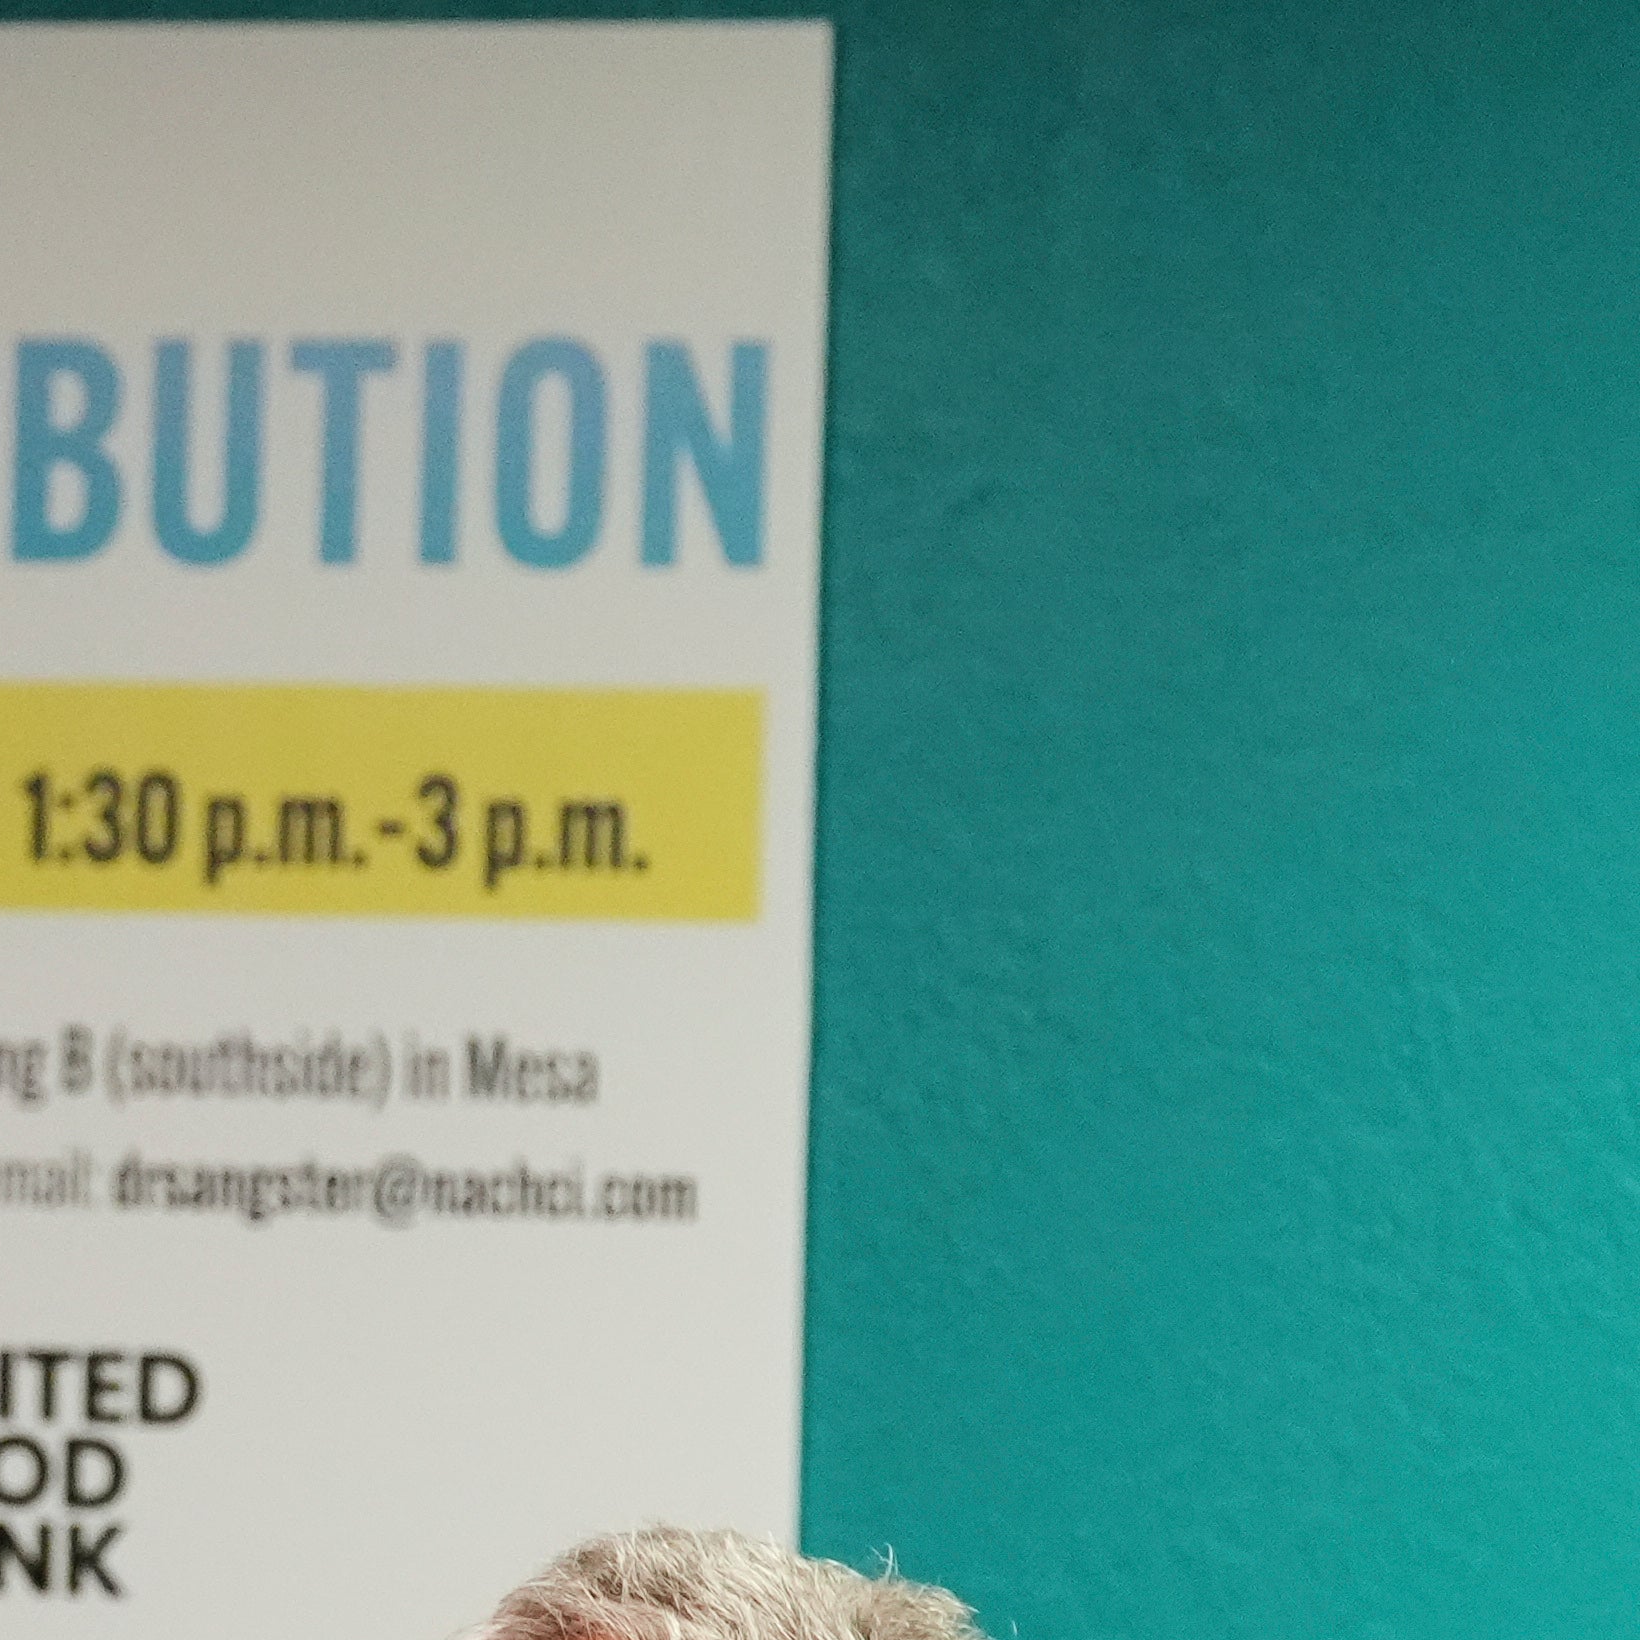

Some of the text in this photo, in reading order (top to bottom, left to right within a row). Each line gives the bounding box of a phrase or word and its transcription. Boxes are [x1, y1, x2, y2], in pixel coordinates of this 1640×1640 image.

[22, 767, 182, 868] 1:30
[201, 772, 461, 889] p.m.-3
[481, 798, 650, 894] p.m.
[59, 1024, 94, 1095] B
[402, 1040, 451, 1100] in
[463, 1034, 598, 1104] Mesa
